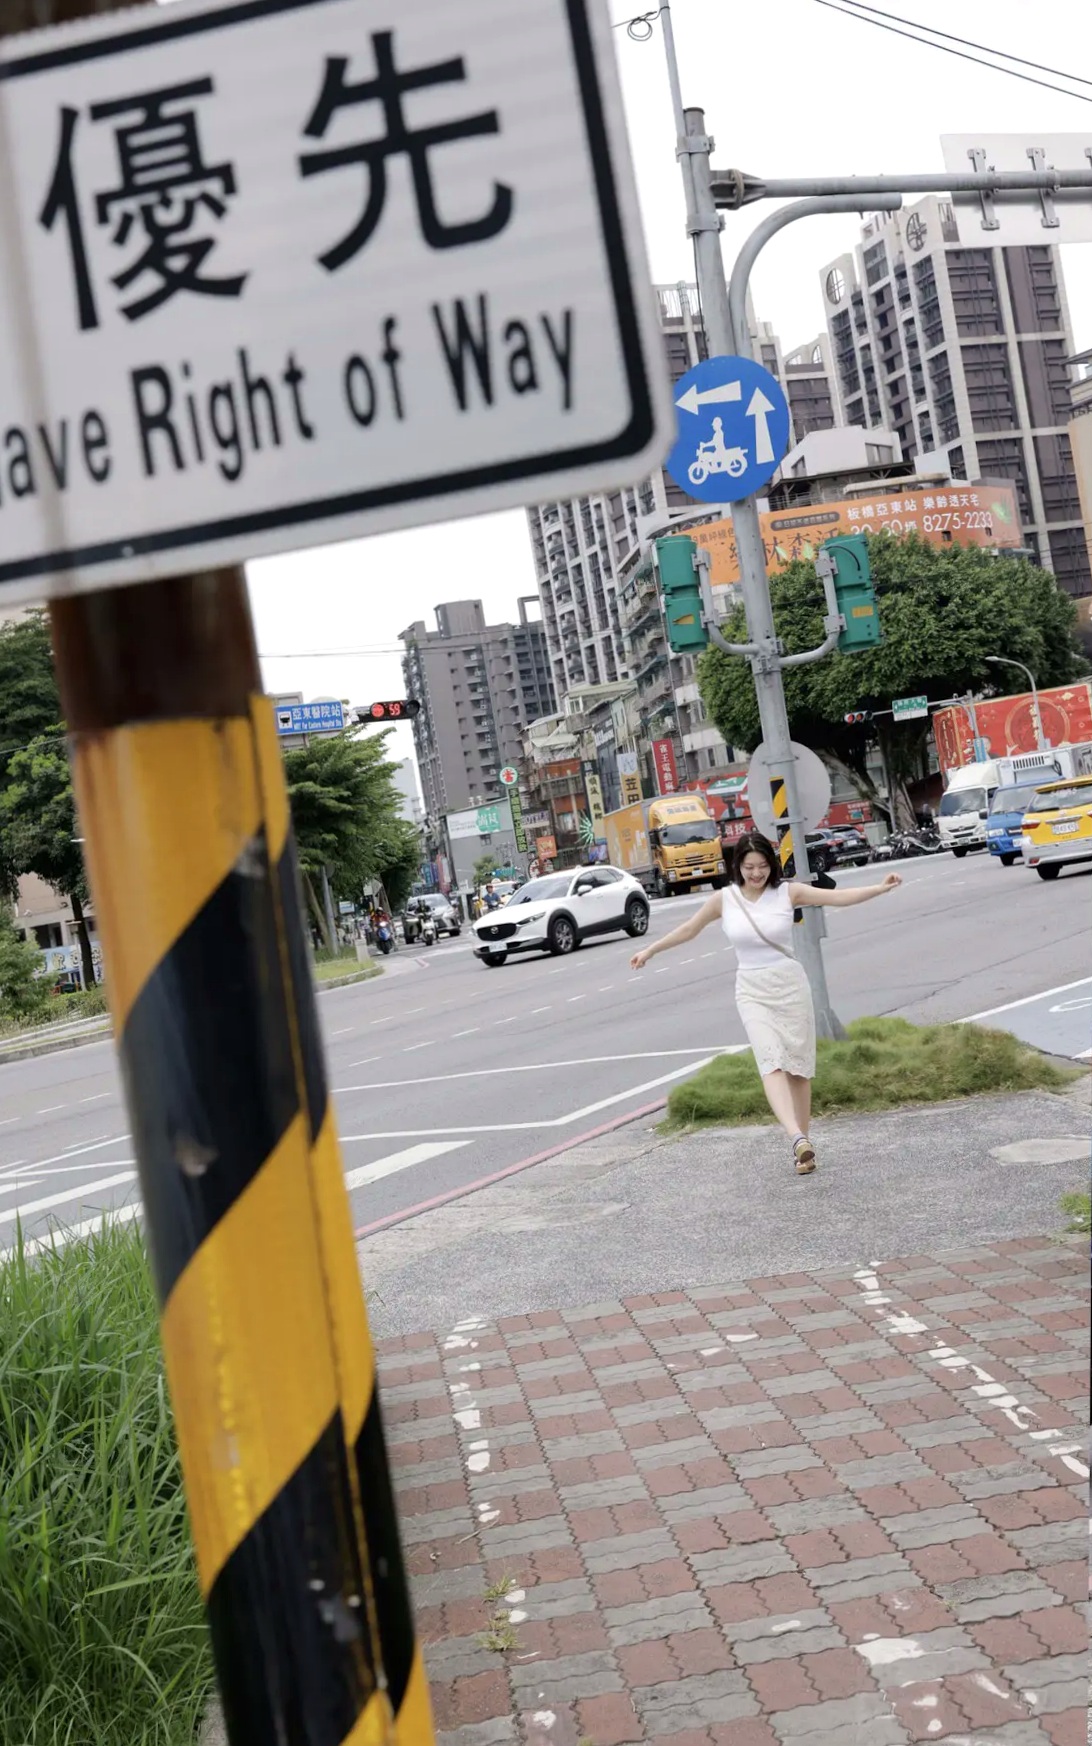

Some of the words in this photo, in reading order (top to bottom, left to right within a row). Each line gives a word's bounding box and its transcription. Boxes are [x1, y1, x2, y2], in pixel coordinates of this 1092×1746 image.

[39, 27, 515, 331] 優先
[130, 350, 315, 482] Right
[344, 316, 404, 427] of
[433, 293, 577, 412] Way
[923, 511, 993, 533] 8275-2233
[292, 704, 340, 720] 亞東醫院站
[388, 703, 401, 716] 59
